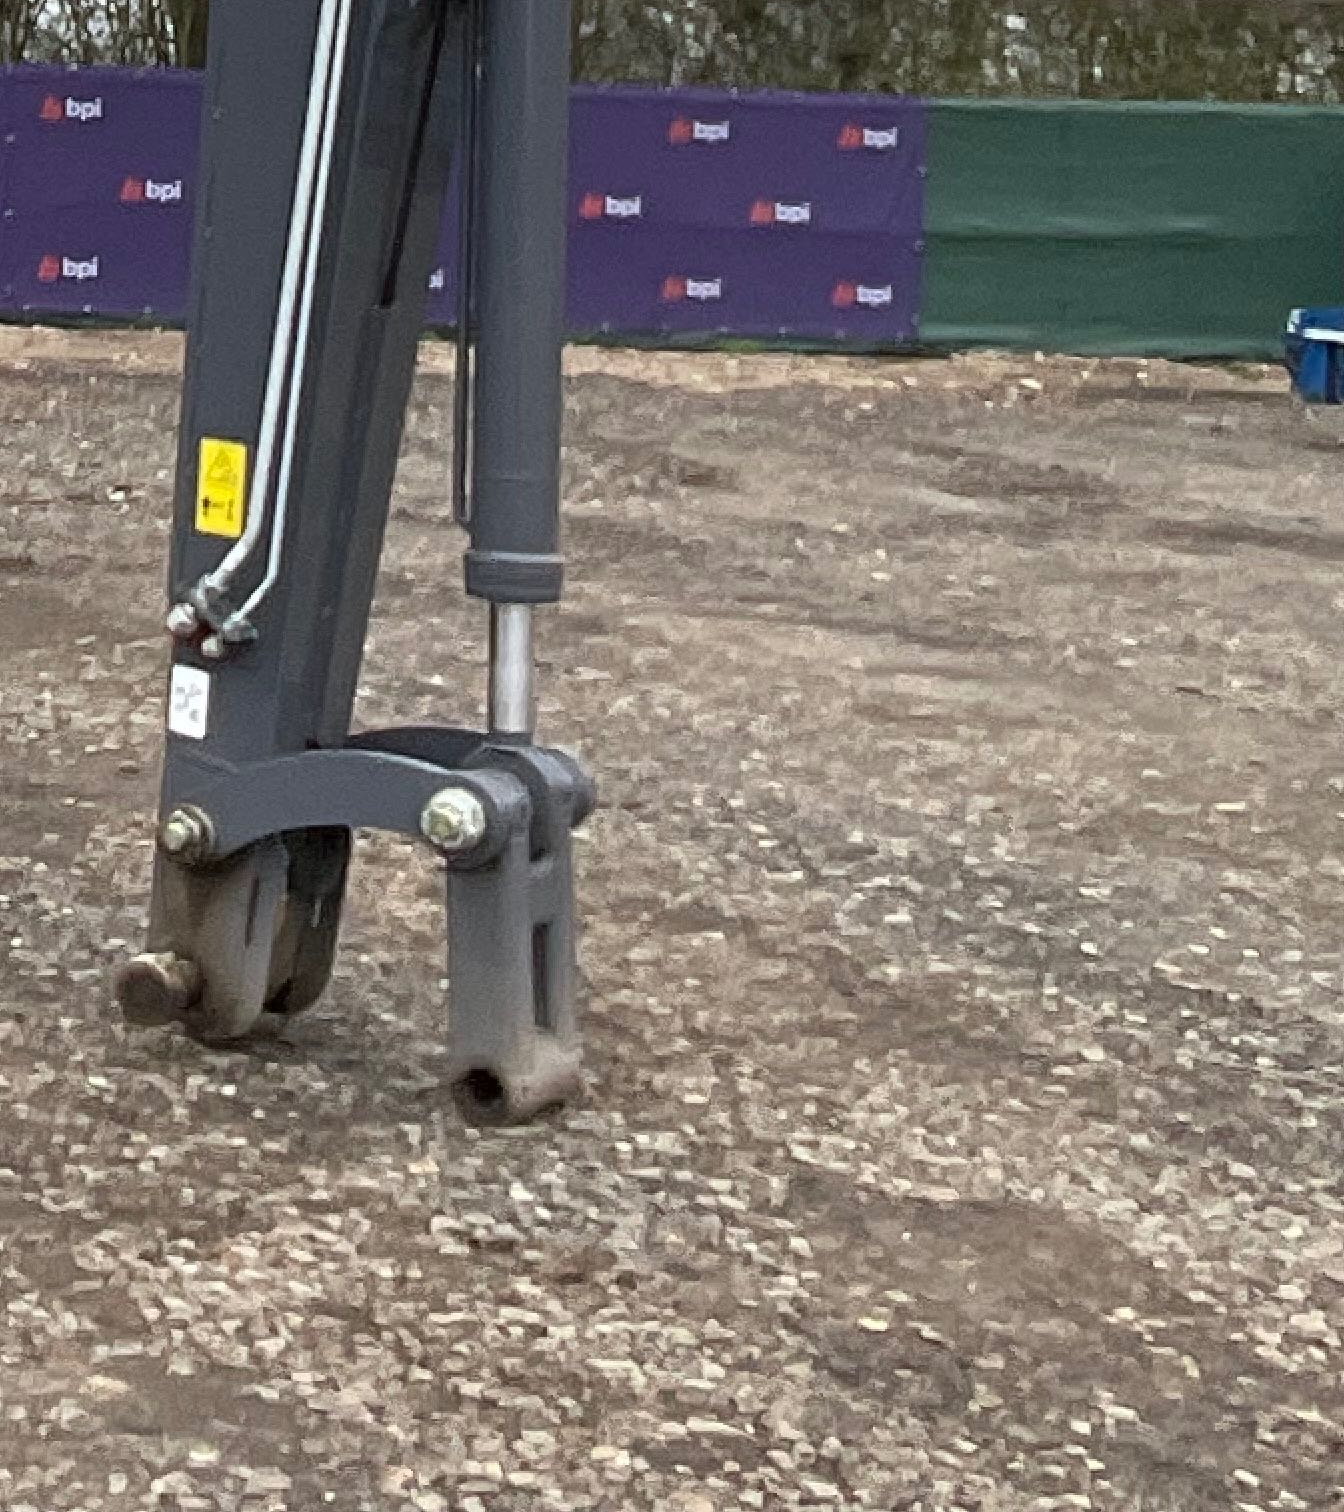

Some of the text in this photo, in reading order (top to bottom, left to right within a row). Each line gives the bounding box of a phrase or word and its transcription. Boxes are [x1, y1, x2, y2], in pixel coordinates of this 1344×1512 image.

[66, 96, 102, 122] bpi
[144, 179, 182, 203] bpi
[62, 256, 98, 280] bpi
